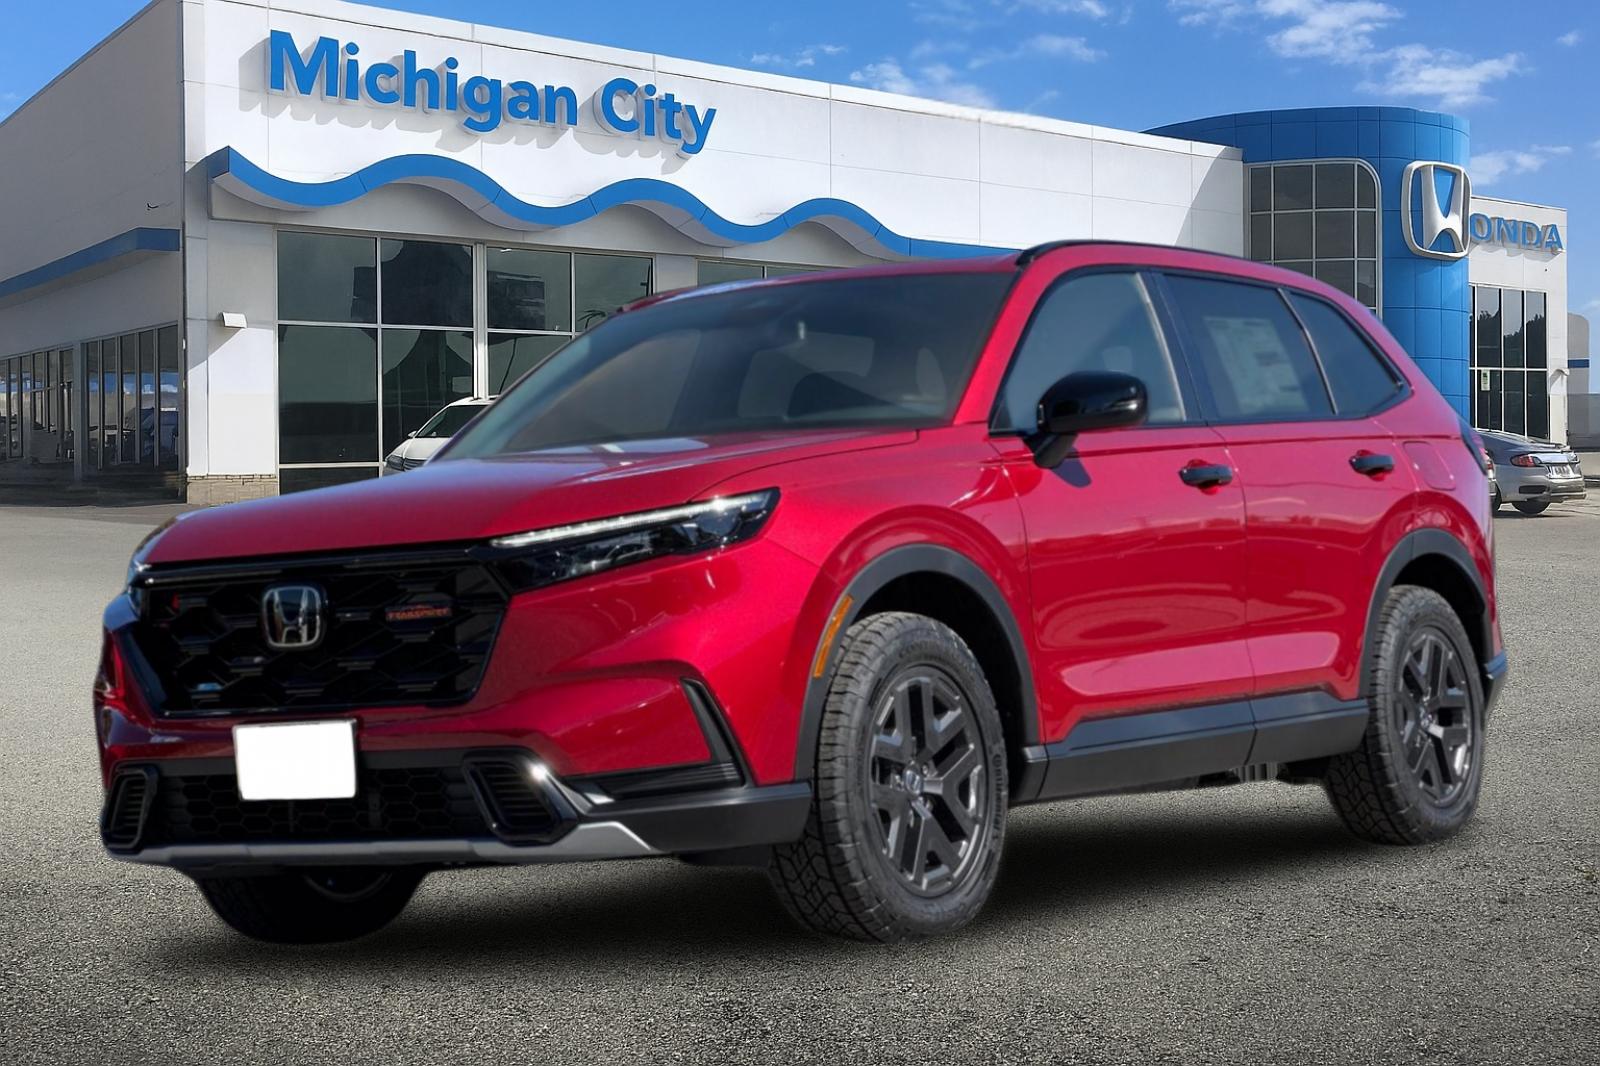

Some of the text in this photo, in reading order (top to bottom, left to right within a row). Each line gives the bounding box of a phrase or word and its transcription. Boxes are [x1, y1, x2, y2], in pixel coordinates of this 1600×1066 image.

[269, 29, 717, 155] Michigan City
[1469, 212, 1564, 250] ONDA
